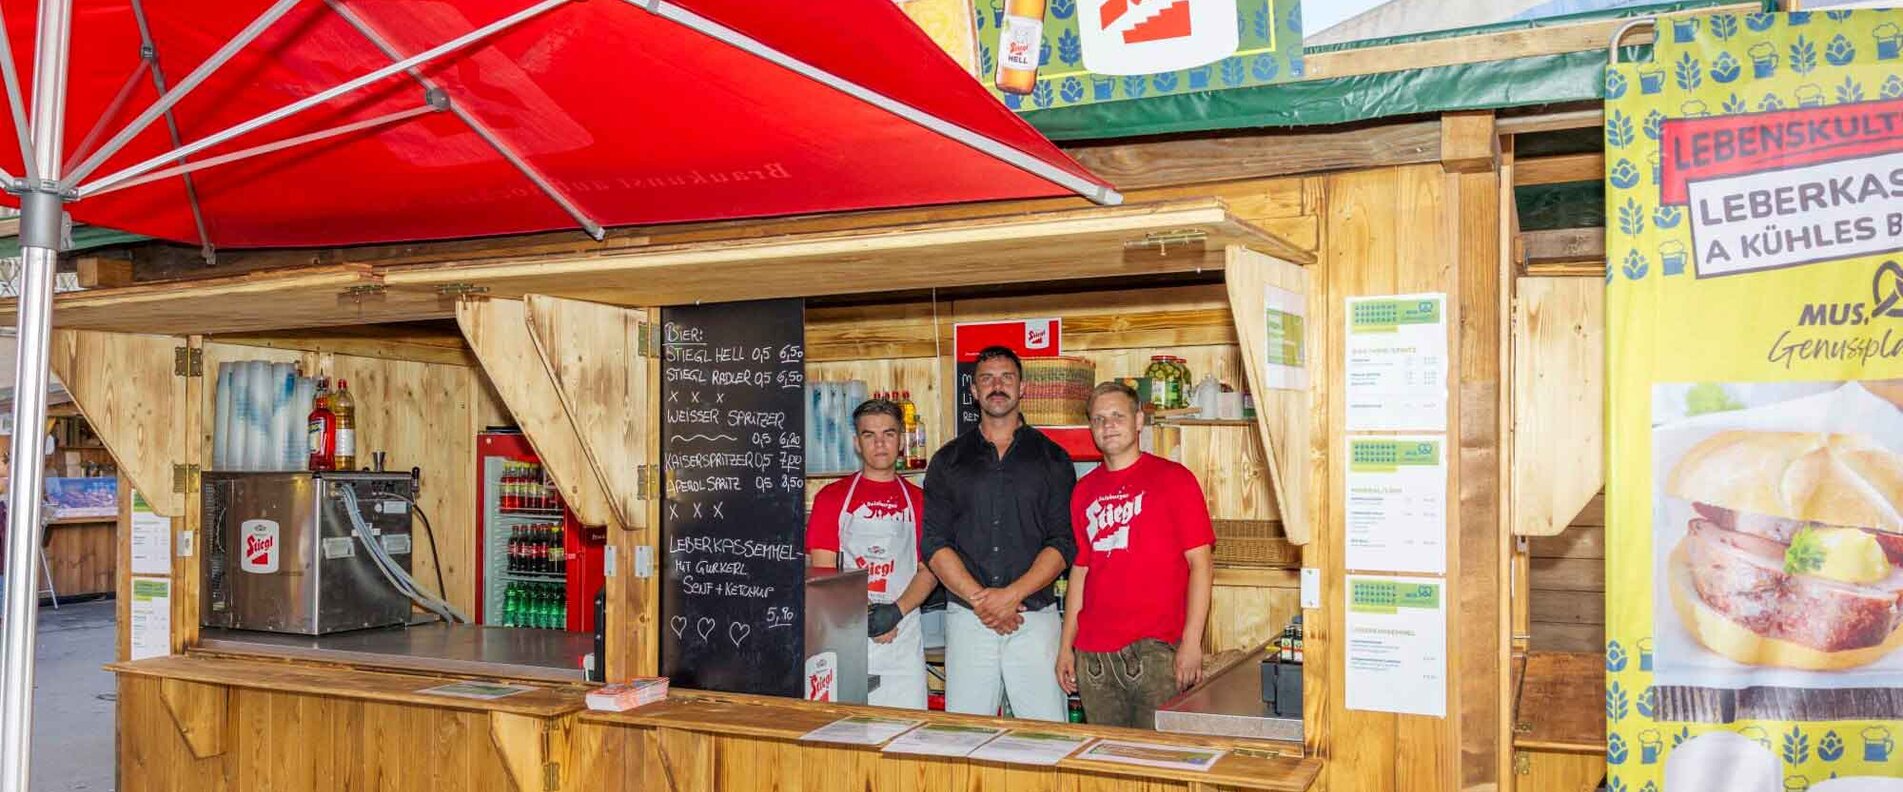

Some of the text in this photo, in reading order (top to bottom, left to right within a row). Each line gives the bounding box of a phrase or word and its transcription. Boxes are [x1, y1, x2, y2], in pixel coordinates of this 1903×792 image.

[1008, 55, 1028, 64] HELL
[1674, 110, 1903, 171] LEBENSKULT
[1705, 239, 1731, 265] A
[1740, 216, 1877, 260] KÜHLES
[1797, 302, 1869, 326] MUS.
[666, 344, 804, 364] STIEGL HELL 0,5 6,50
[666, 367, 803, 388] STIEGL RADLER 0,5 6,50
[752, 432, 771, 448] 0,5
[754, 452, 774, 473] 0,5
[666, 479, 706, 493] APEROL
[755, 476, 773, 493] 0,5
[781, 474, 804, 493] 8,50
[1086, 490, 1145, 544] Stiegl
[246, 533, 274, 558] Stiegl
